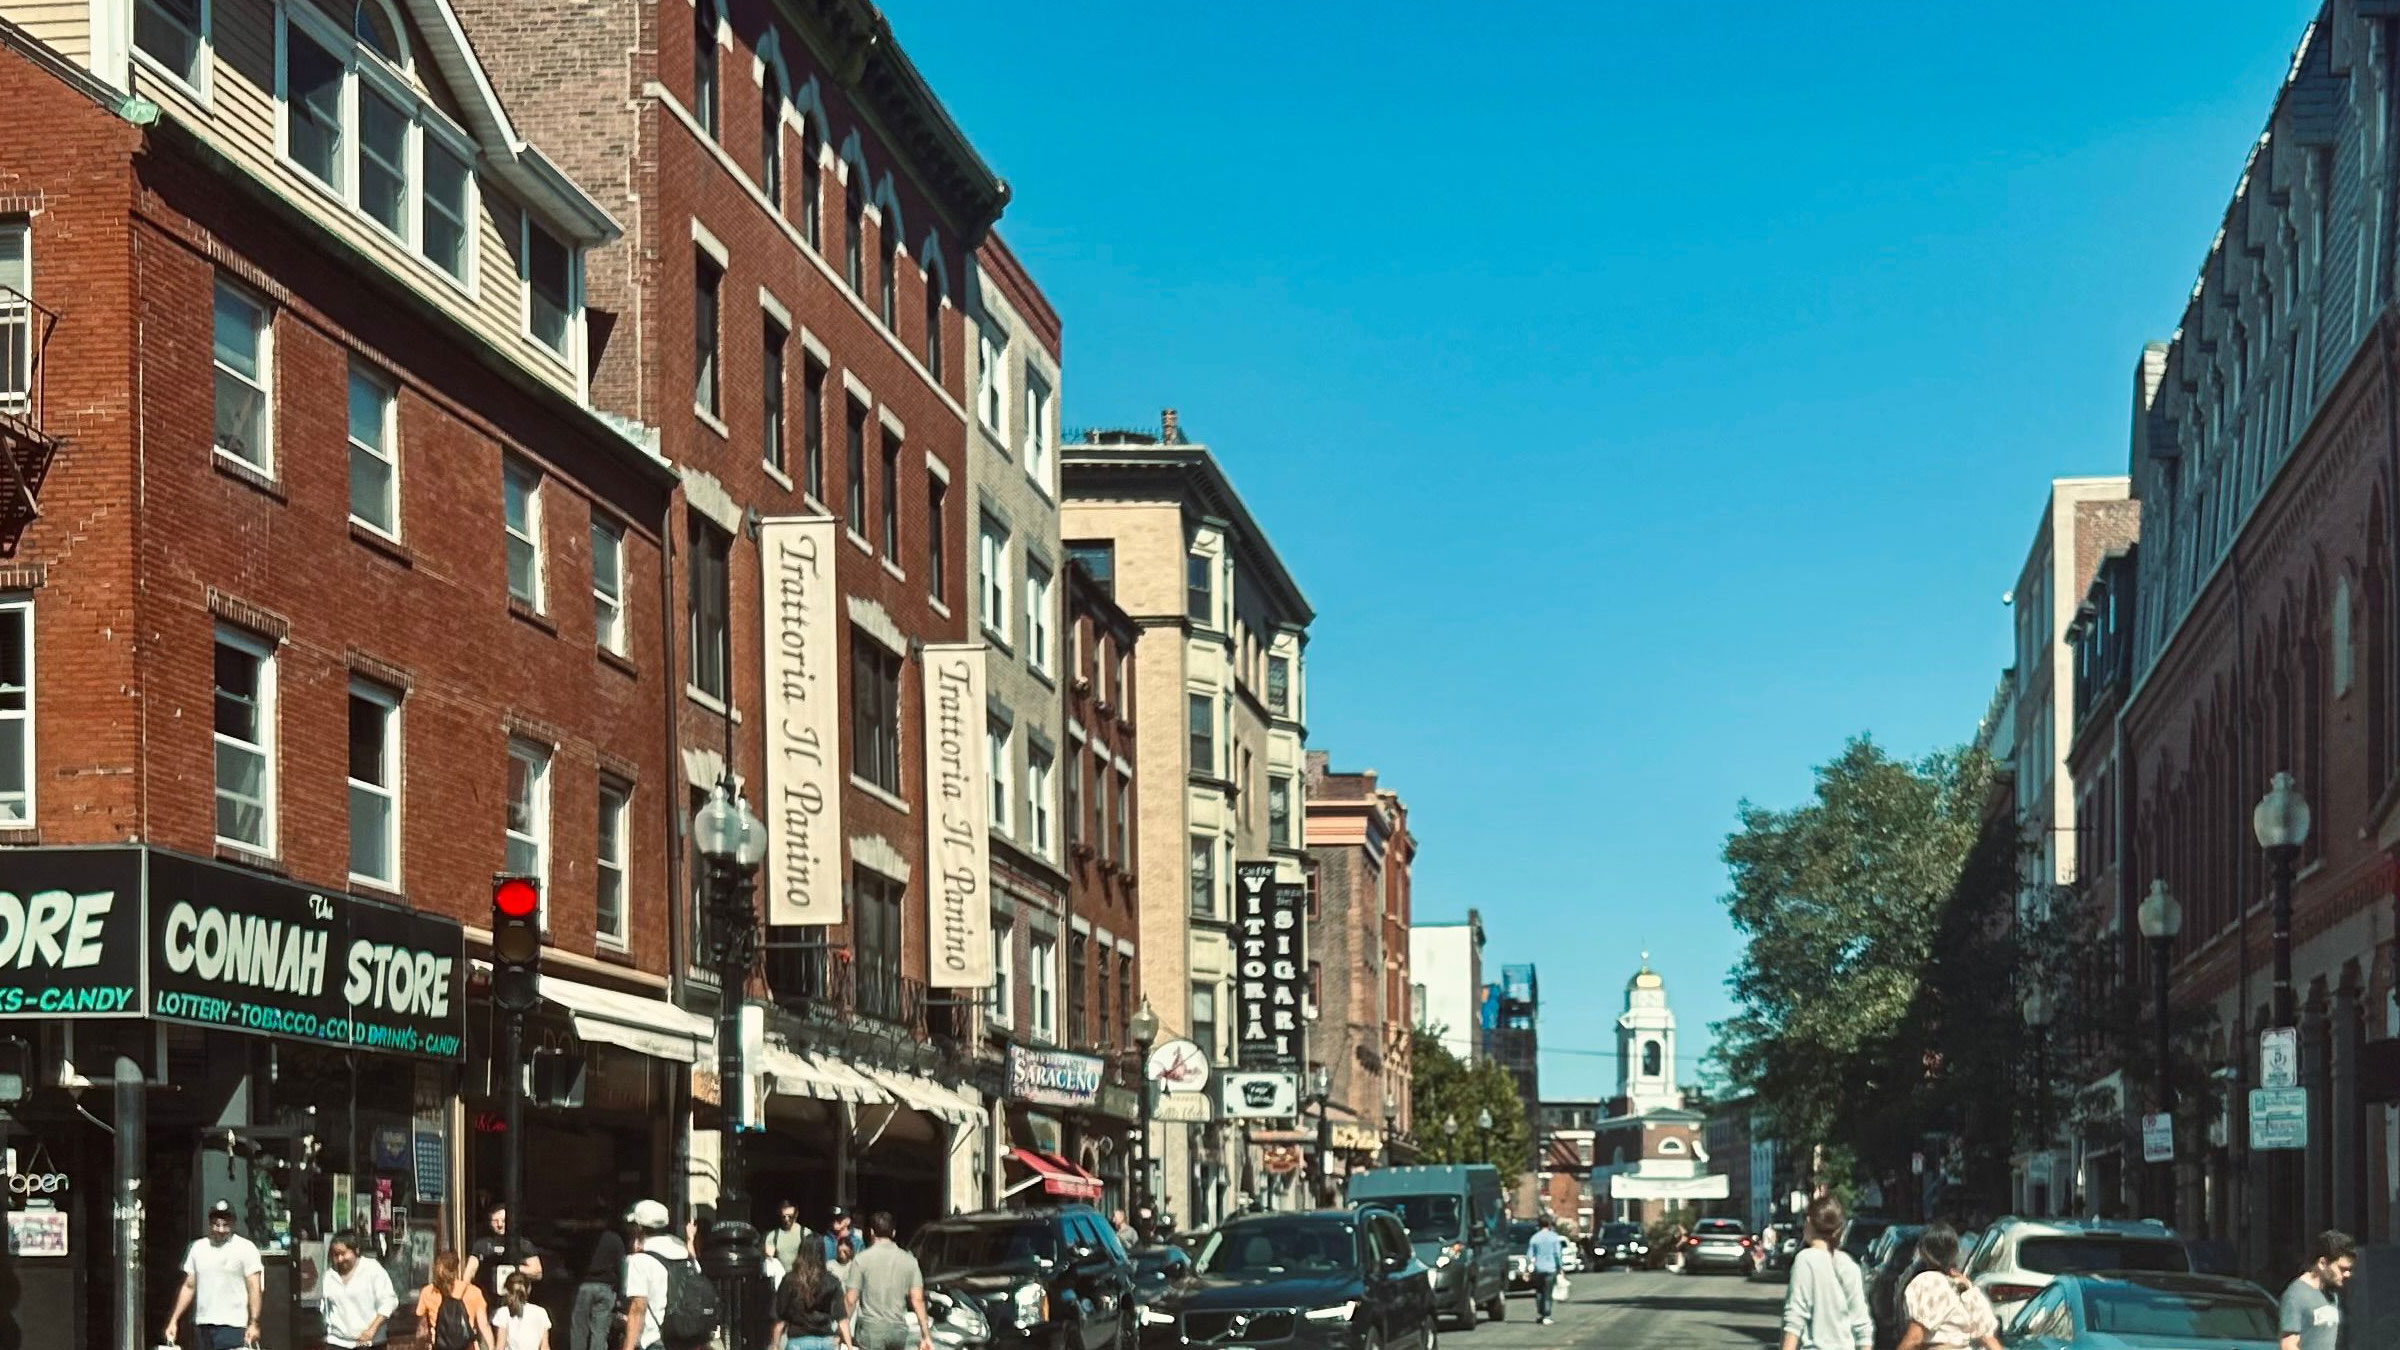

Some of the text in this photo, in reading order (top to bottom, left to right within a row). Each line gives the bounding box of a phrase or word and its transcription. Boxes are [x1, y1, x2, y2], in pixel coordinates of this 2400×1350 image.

[780, 534, 821, 702] Trattoria
[938, 659, 974, 799] Trattoria
[784, 782, 824, 908] Panino
[164, 900, 452, 1018] CONNAH STORE
[943, 866, 976, 971] Panino
[1243, 876, 1267, 1040] VITTORIA
[1273, 910, 1295, 1055] SIGARI
[9, 1173, 69, 1197] open
